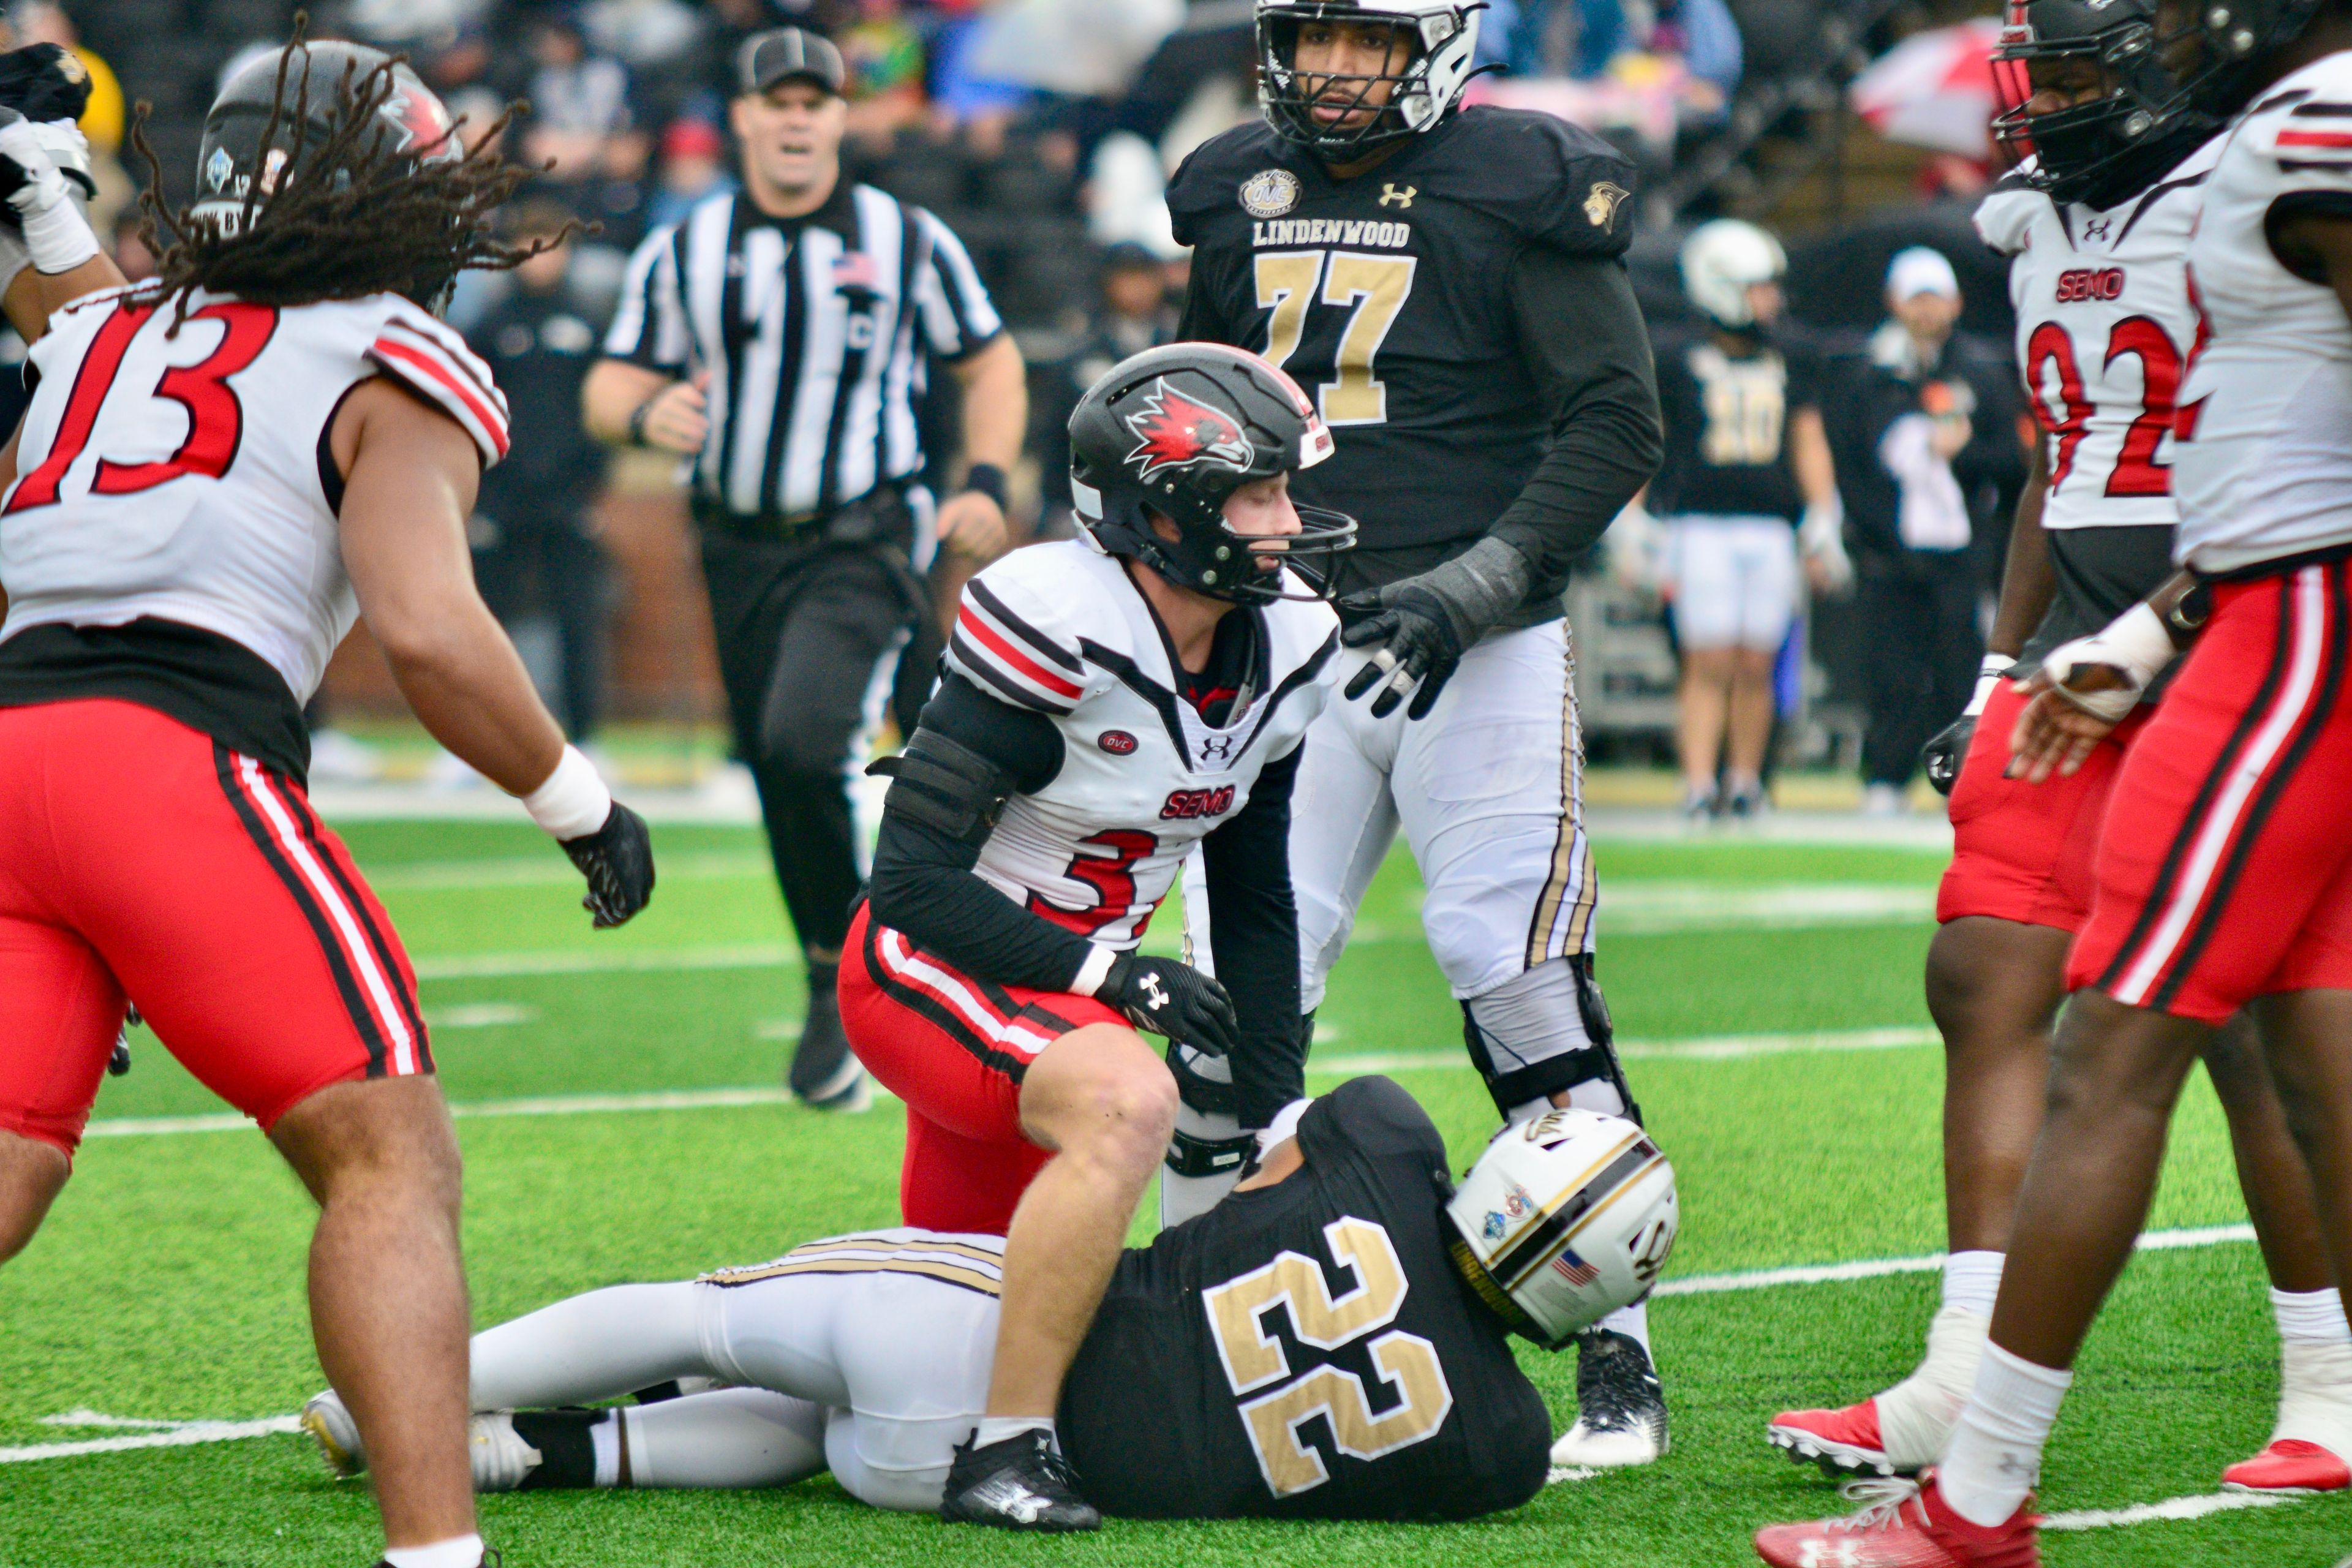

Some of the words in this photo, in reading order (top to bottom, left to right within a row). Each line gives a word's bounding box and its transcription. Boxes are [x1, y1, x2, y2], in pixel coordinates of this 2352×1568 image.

[1252, 184, 1289, 203] OVC
[1253, 219, 1411, 248] LINDENWOOD
[2056, 267, 2125, 303] SEMO
[1254, 249, 1418, 426] 77
[1, 295, 281, 518] 13
[2026, 314, 2185, 498] 92
[1107, 737, 1129, 749] OVC
[1159, 784, 1236, 820] SEMO
[1025, 828, 1159, 938] 3
[1202, 1215, 1453, 1499] 22
